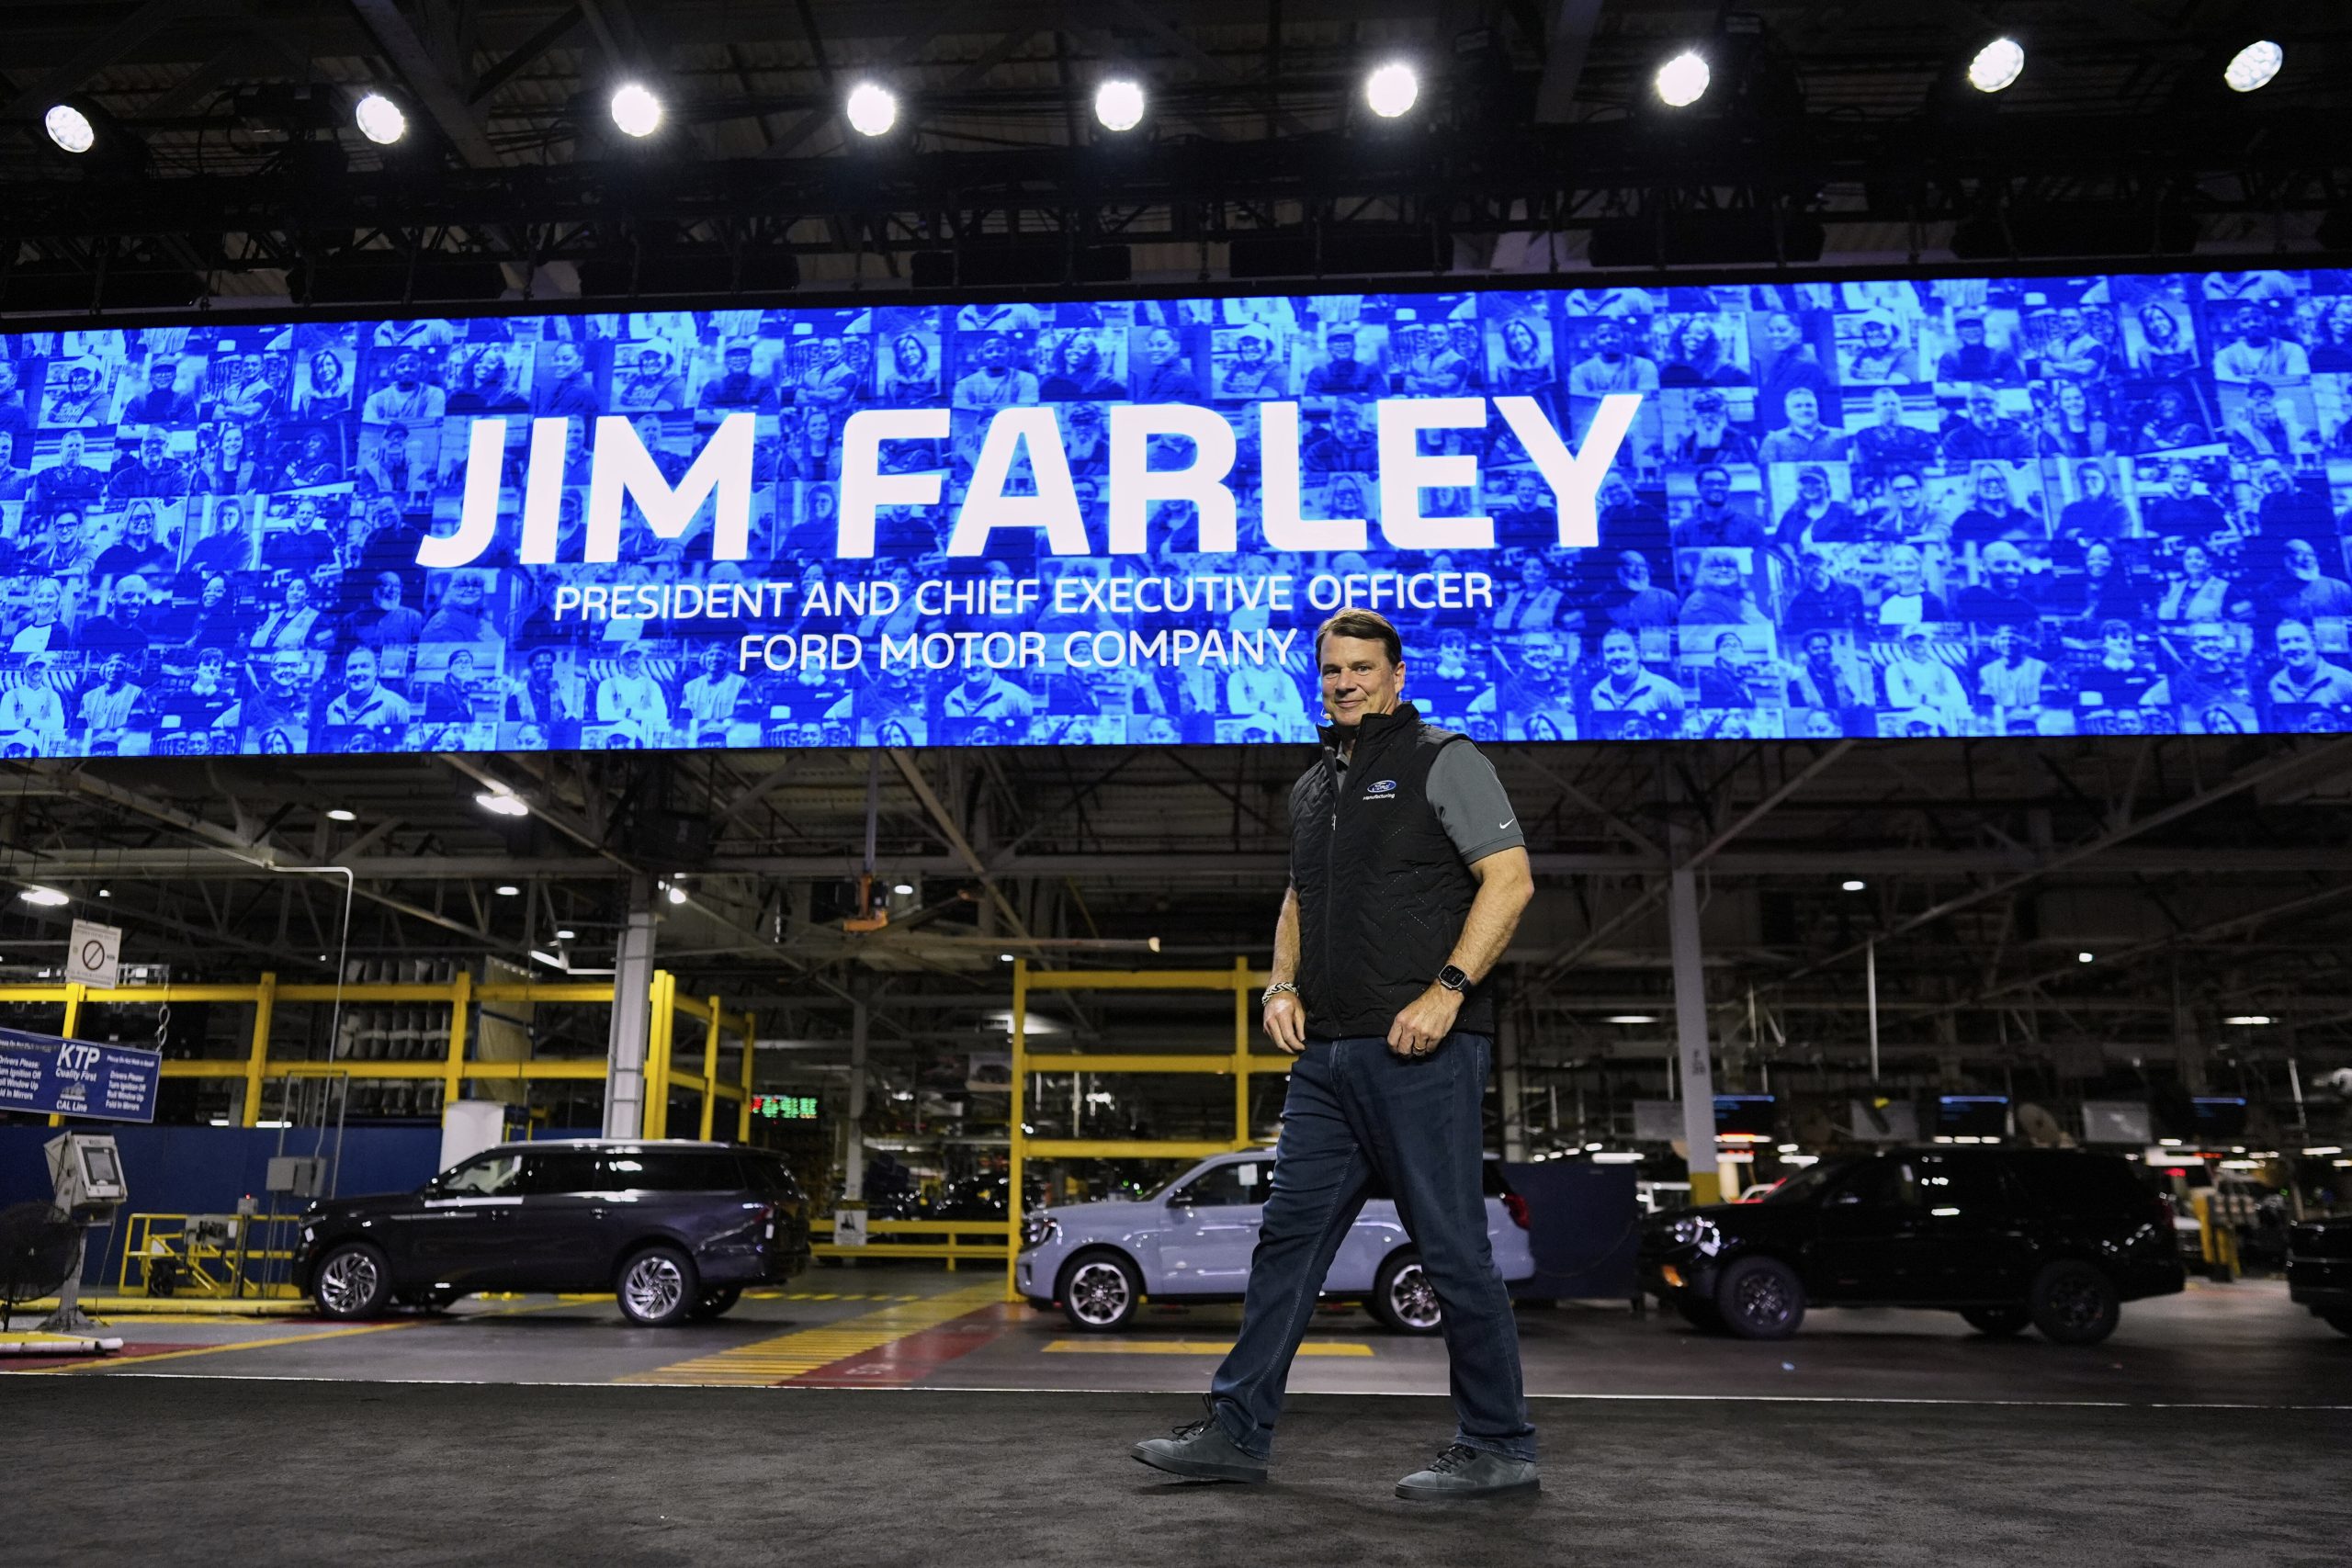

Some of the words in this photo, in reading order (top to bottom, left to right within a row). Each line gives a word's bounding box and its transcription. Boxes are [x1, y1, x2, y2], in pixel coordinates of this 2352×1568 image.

[415, 412, 756, 569] JIM
[837, 393, 1644, 558] FARLEY
[554, 582, 793, 621] PRESIDENT
[801, 581, 899, 617] AND
[915, 579, 1040, 615] CHIEF
[1055, 576, 1293, 613] EXECUTIVE
[1308, 572, 1492, 610] OFFICER
[740, 634, 862, 671] FORD
[880, 631, 1046, 670] MOTOR
[1063, 627, 1298, 668] COMPANY
[57, 1043, 100, 1070] KTP
[30, 1080, 39, 1091] Up
[56, 1066, 80, 1081] Quality
[81, 1070, 97, 1082] First
[56, 1100, 71, 1111] CAL
[72, 1101, 88, 1112] Line
